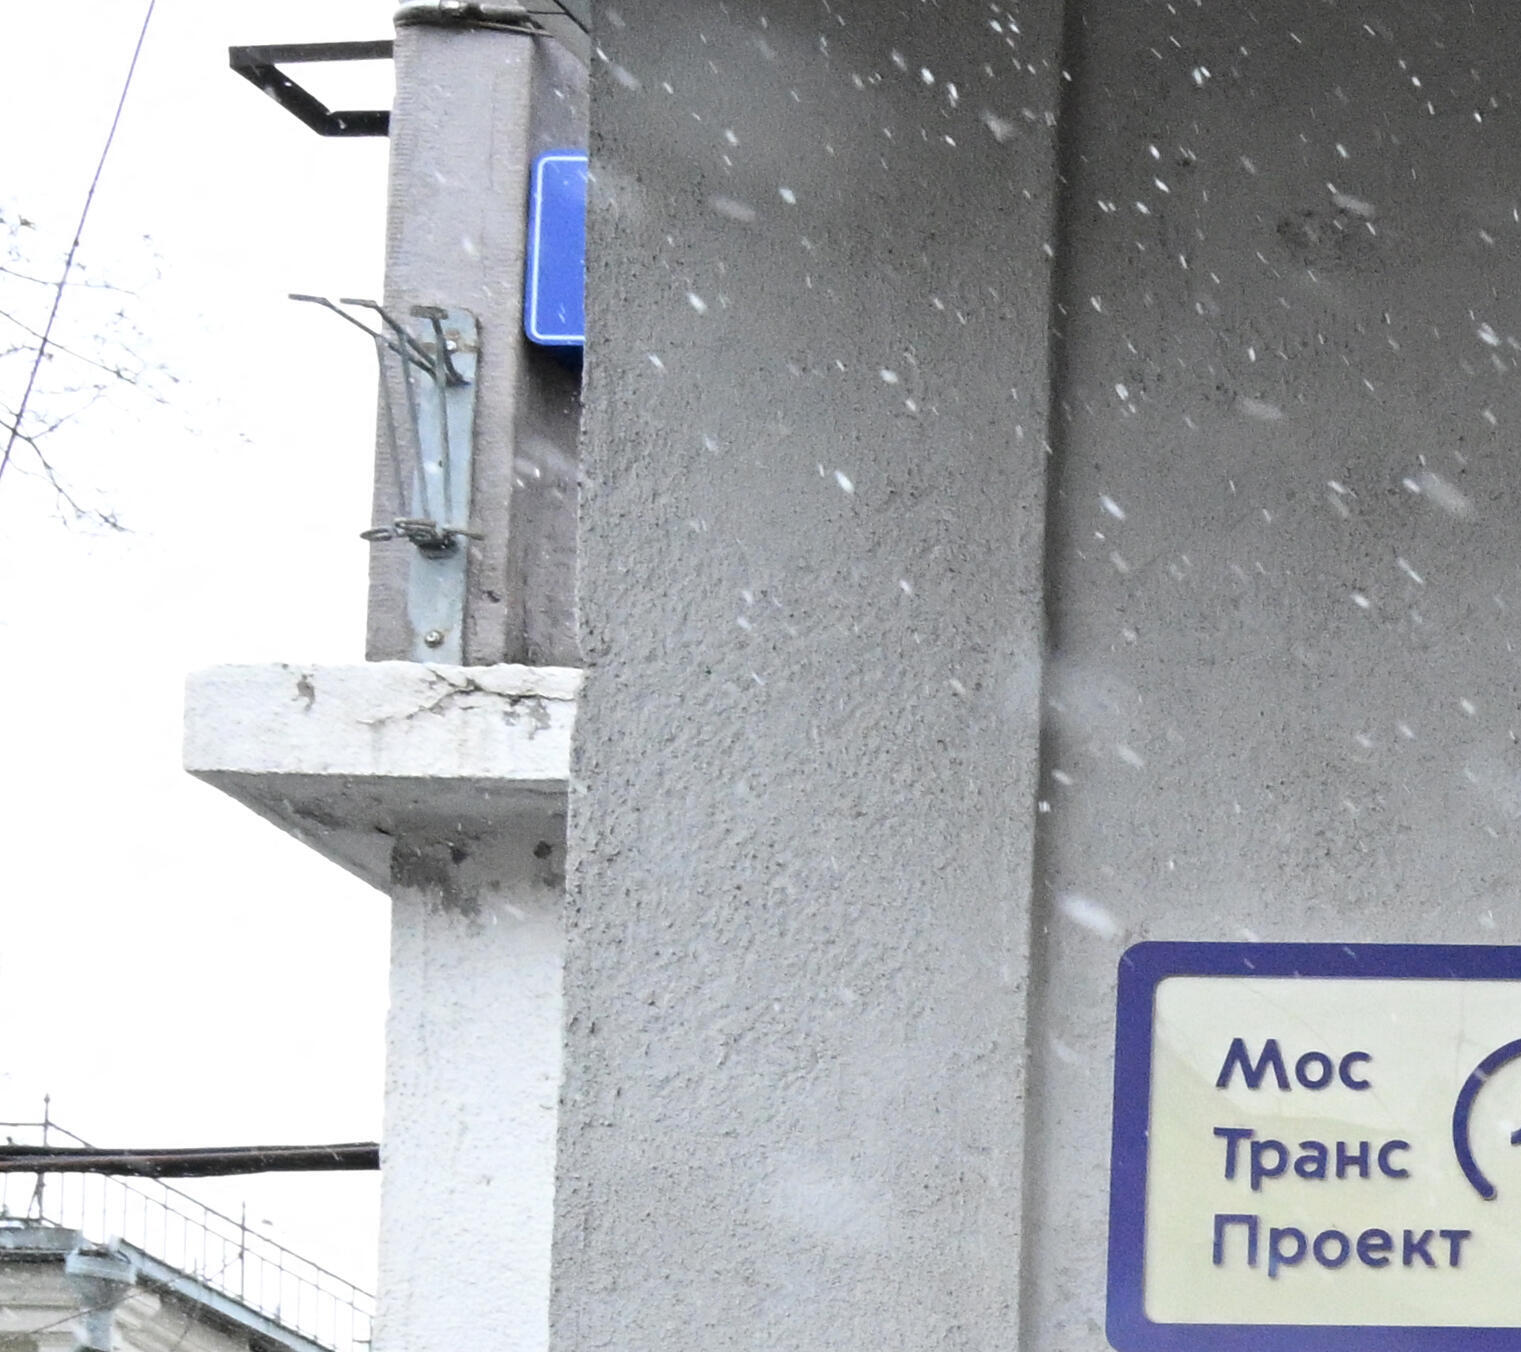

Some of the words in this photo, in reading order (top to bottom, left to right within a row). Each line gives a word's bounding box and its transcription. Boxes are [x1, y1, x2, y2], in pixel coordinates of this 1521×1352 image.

[1214, 1037, 1372, 1092] Мос
[1214, 1127, 1412, 1192] Транс
[1212, 1213, 1472, 1280] Проект
